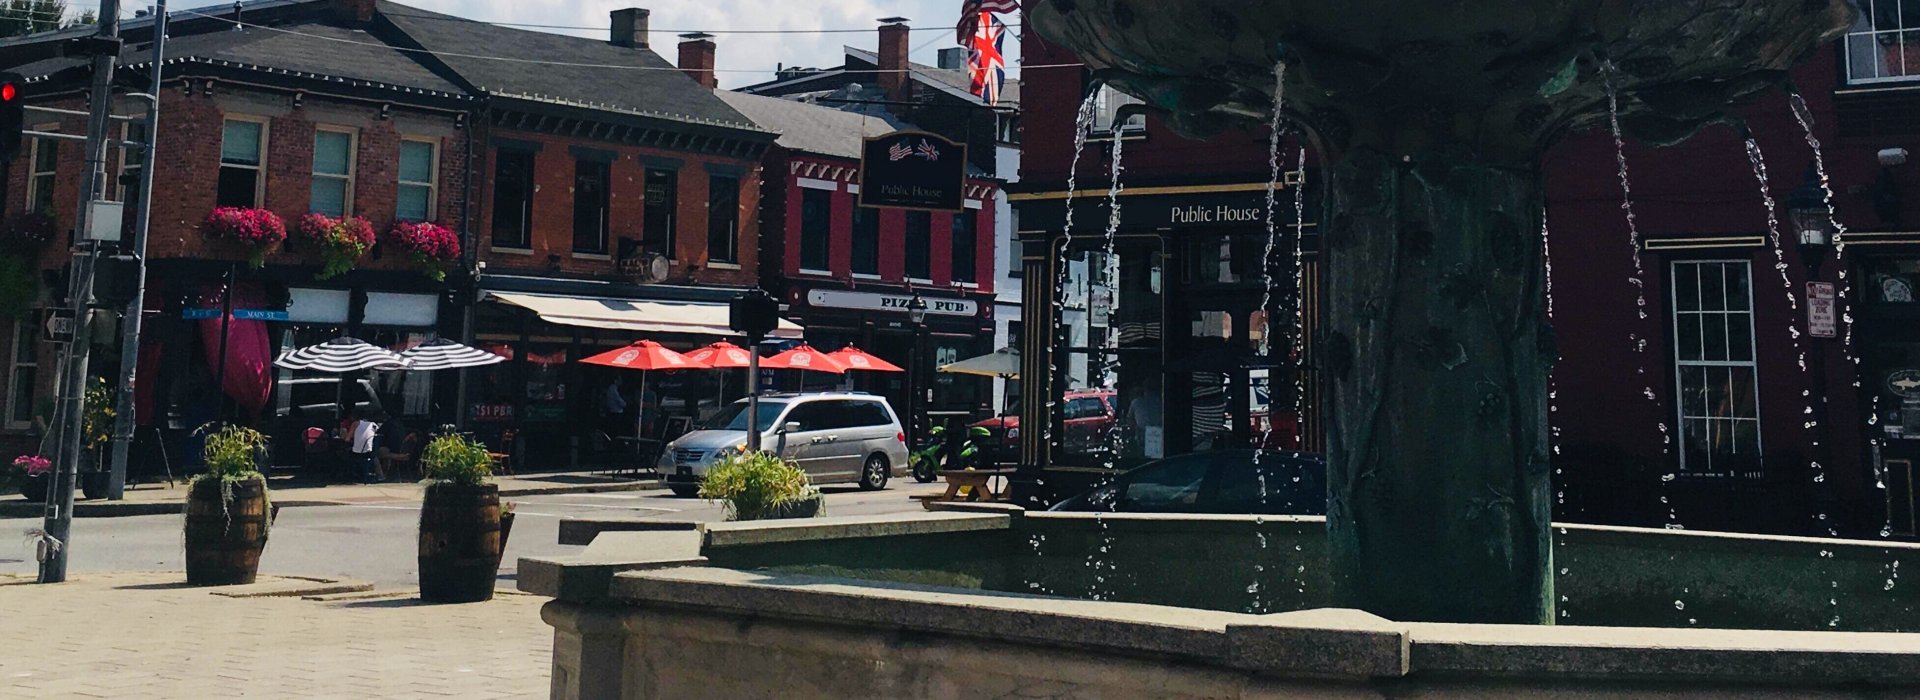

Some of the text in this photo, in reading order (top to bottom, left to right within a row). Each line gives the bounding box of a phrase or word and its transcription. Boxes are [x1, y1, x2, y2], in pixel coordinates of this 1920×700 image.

[881, 184, 943, 198] Public House
[1171, 205, 1260, 222] Public House
[881, 297, 965, 311] PIZA PUB
